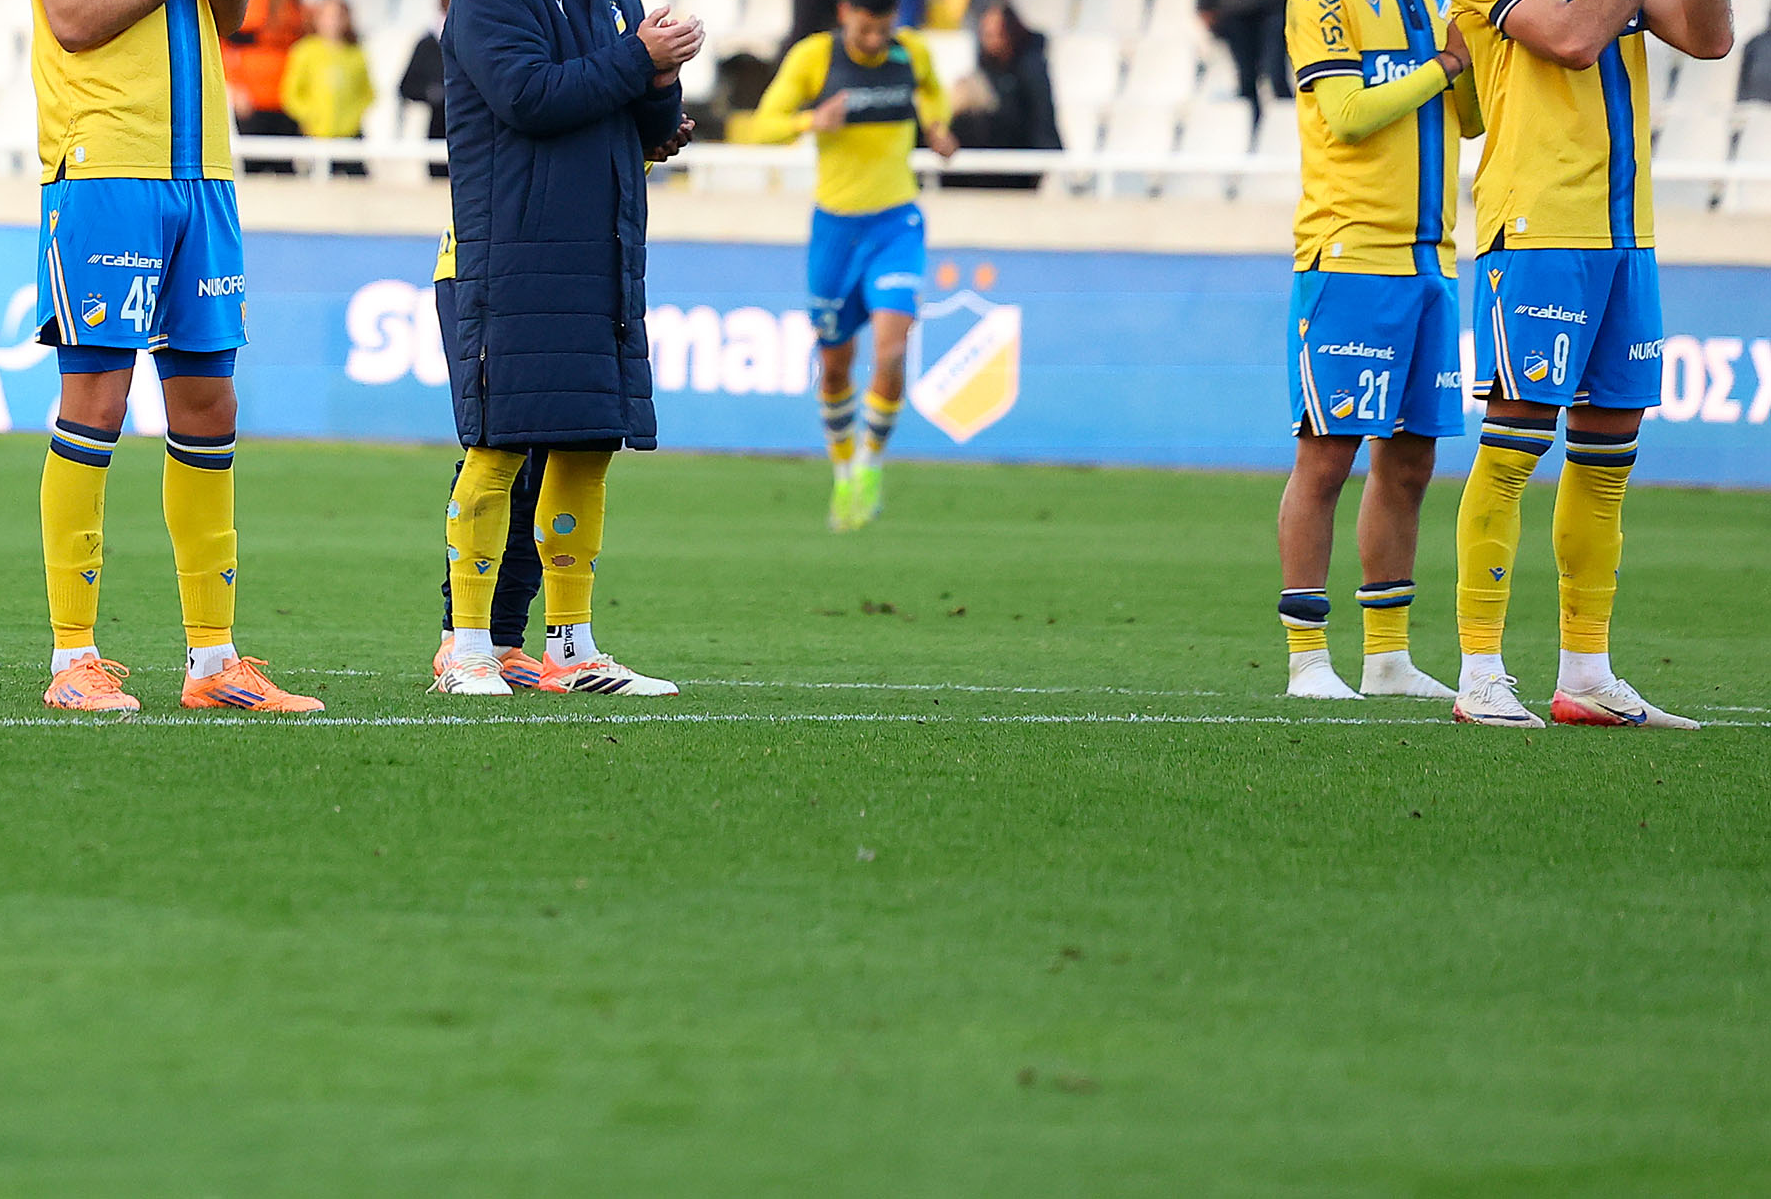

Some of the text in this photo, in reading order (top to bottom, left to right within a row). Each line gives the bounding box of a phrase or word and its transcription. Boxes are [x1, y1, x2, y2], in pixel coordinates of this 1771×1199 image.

[102, 251, 163, 269] cablene
[120, 275, 159, 332] 45
[1551, 333, 1570, 386] 9
[1357, 369, 1390, 420] 21
